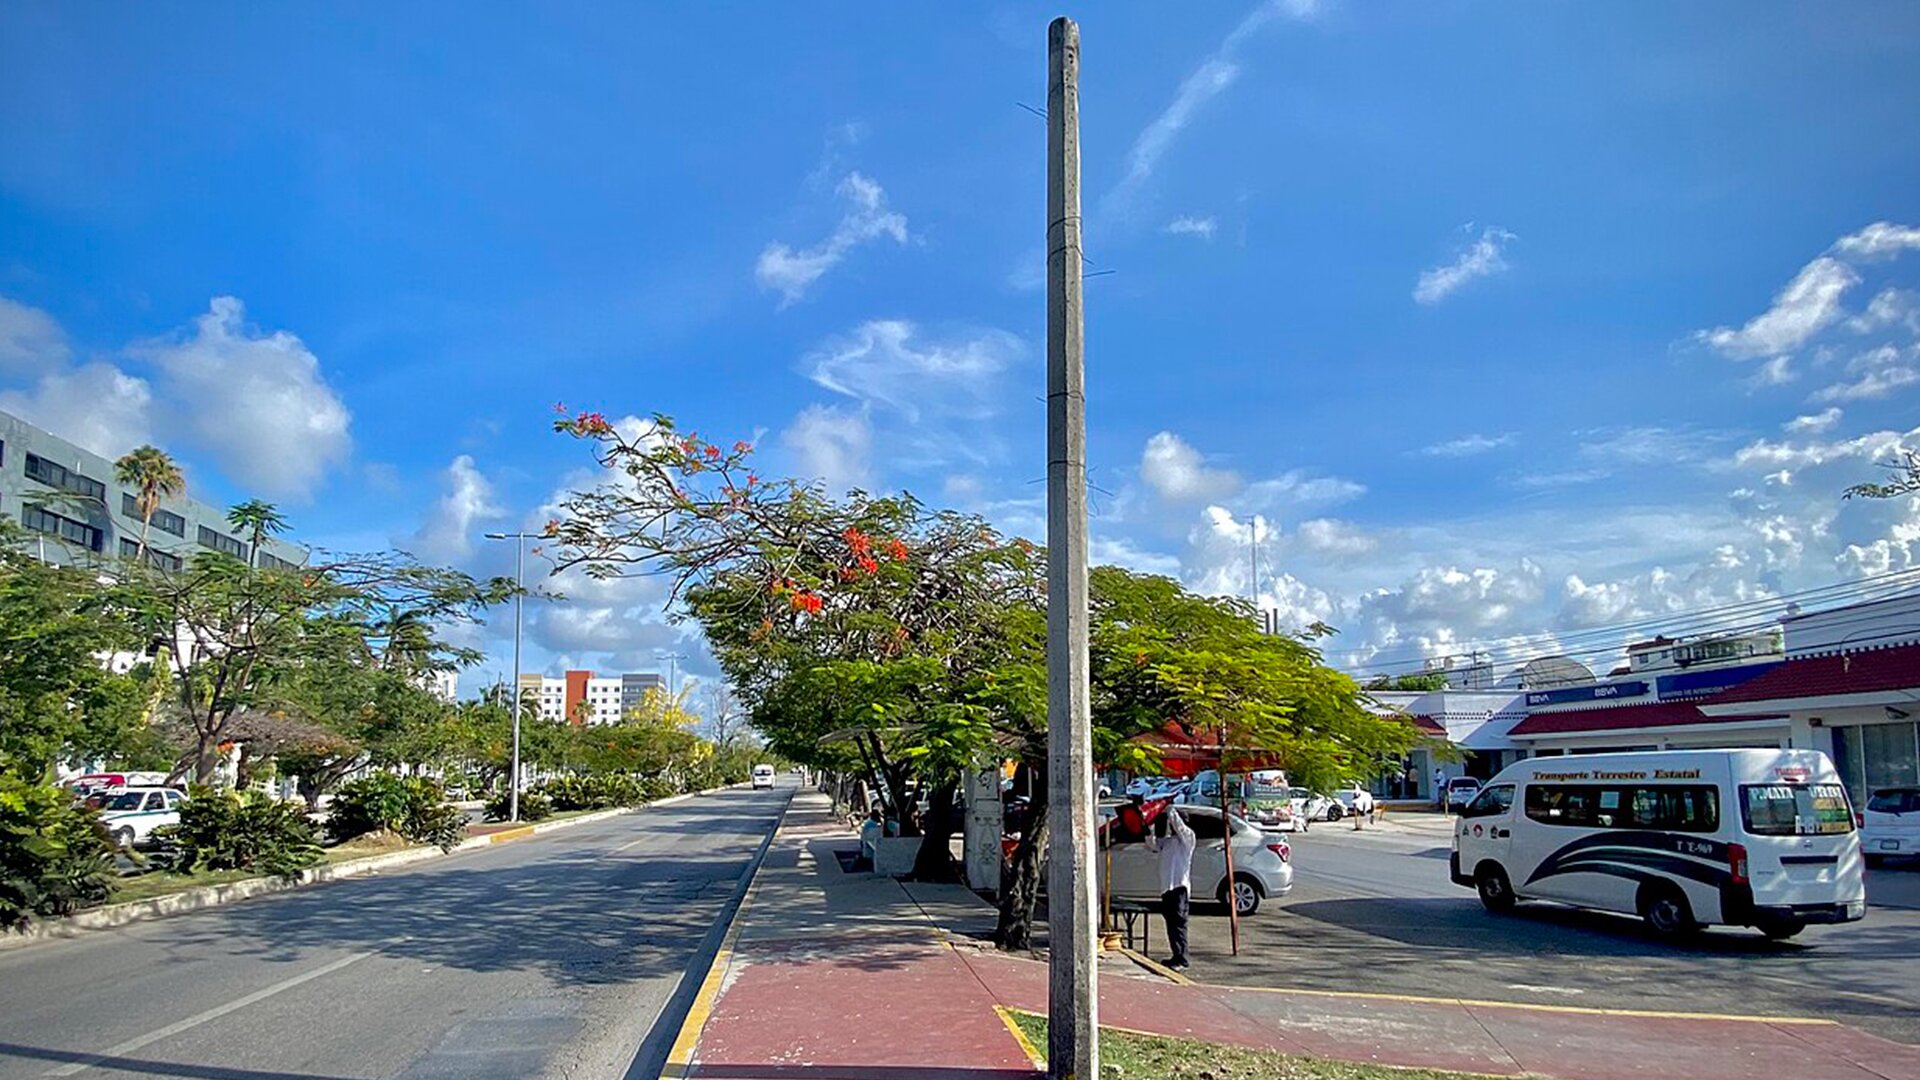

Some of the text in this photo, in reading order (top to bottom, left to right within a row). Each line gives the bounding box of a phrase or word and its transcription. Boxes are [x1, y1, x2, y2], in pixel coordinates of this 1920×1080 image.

[1594, 685, 1618, 697] BBVA
[1529, 693, 1550, 704] BBVA
[1533, 769, 1701, 782] Transporte Terrestre Estatal
